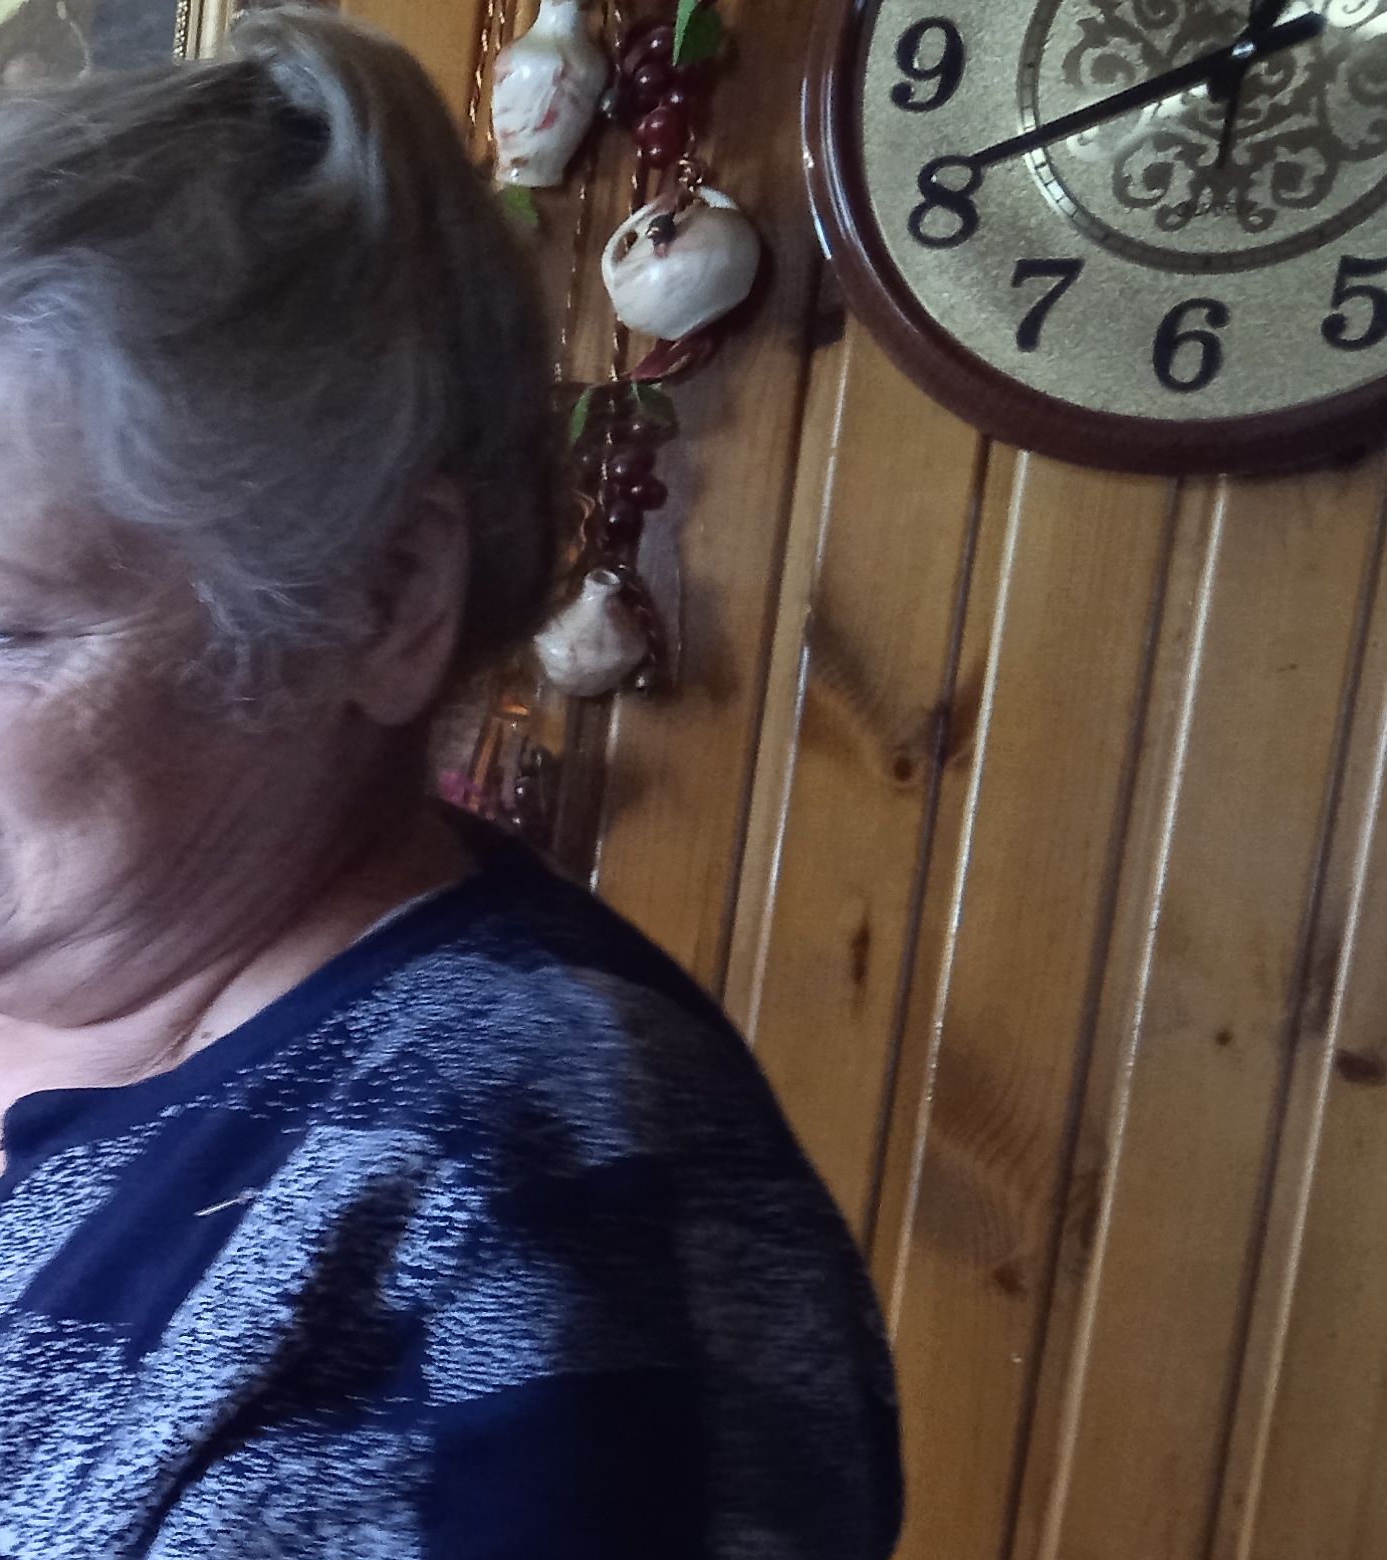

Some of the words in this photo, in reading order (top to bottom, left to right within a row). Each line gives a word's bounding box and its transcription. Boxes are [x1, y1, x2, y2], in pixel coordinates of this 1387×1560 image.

[890, 15, 966, 113] 9
[907, 154, 983, 249] 8
[1010, 257, 1085, 353] 7
[1151, 297, 1231, 394] 6
[1320, 254, 1387, 352] 5
